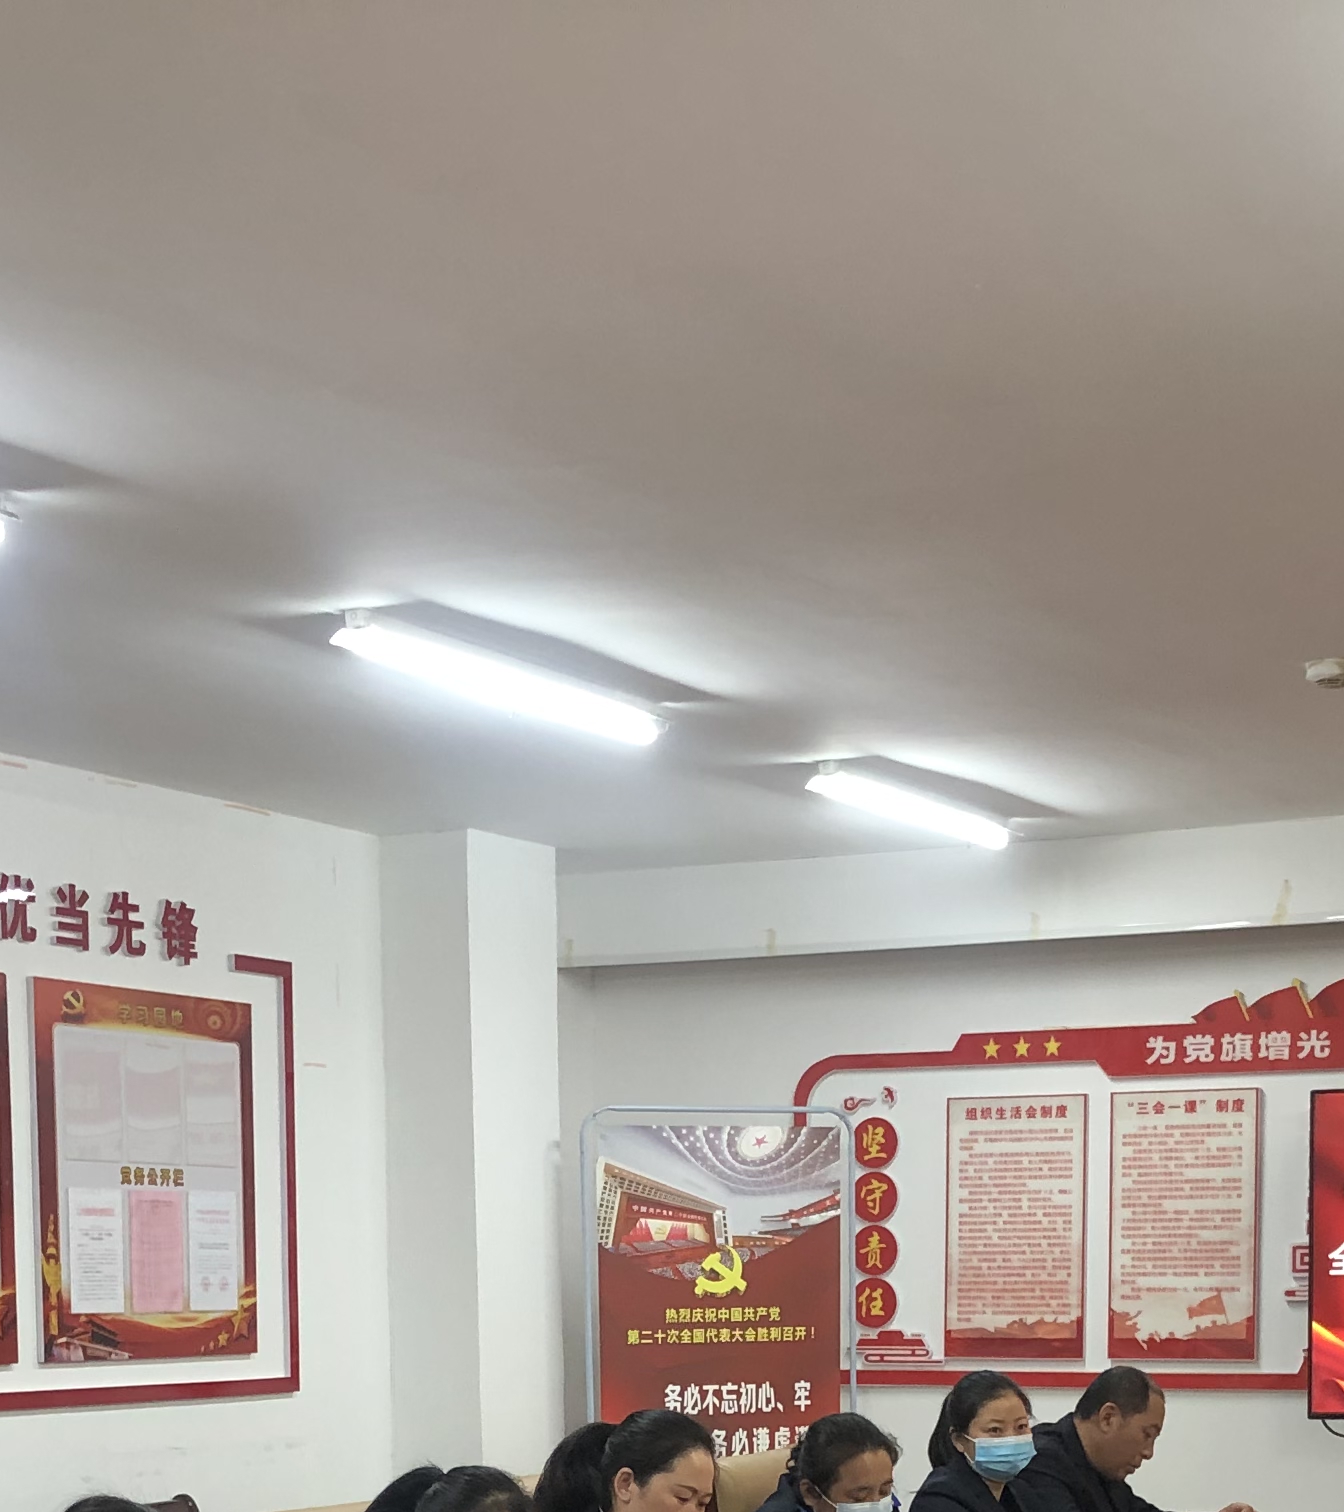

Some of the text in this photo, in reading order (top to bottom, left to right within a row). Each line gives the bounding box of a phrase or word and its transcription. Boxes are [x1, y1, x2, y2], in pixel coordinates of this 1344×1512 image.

[118, 1004, 184, 1028] 学习园地
[1146, 1030, 1331, 1065] 为党旗增光
[965, 1105, 1067, 1120] 组织生活会制度
[858, 1124, 888, 1318] 坚守责任
[665, 1306, 781, 1323] 热烈庆祝中国共产党
[627, 1326, 815, 1345] 第二十次全国代表大会胜利召开！
[664, 1380, 811, 1415] 务必不忘初心、牢
